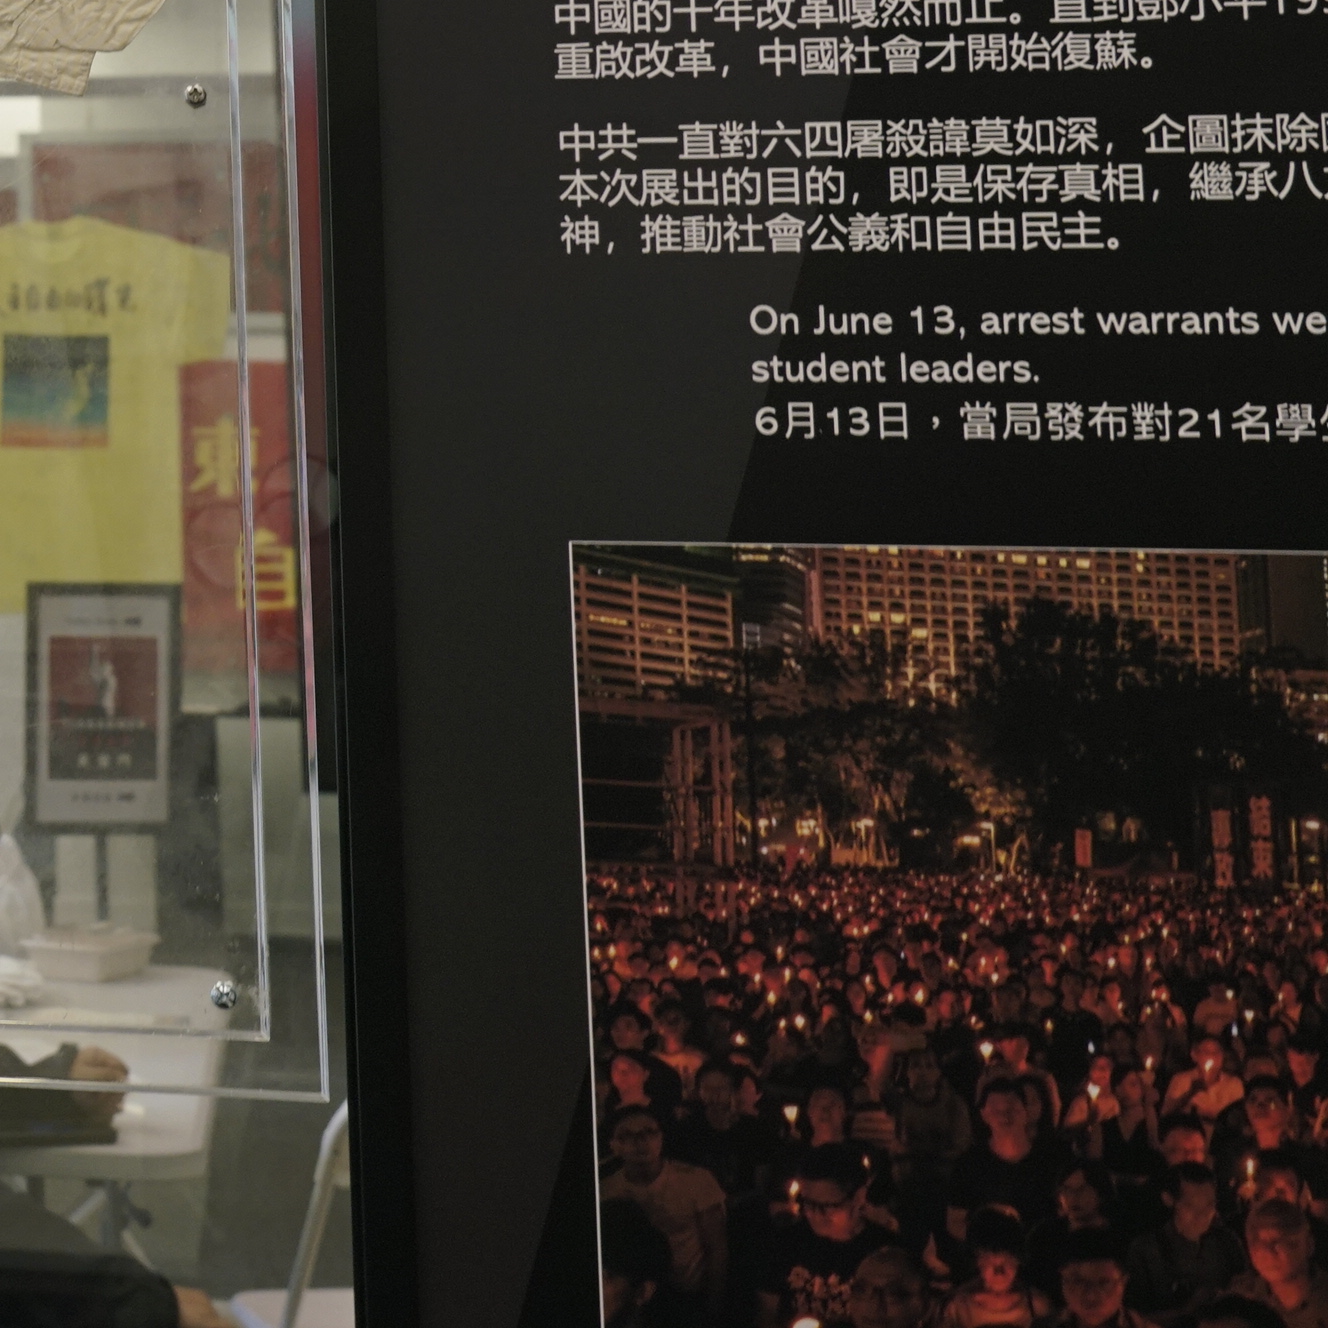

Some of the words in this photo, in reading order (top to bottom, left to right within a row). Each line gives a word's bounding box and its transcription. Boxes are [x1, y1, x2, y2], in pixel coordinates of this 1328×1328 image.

[558, 112, 1328, 162] 中共一直對六四屠殺諱莫如深，企圖抹除
[559, 160, 1328, 208] 本次展出的目的，即是保存真相，繼承八
[750, 305, 799, 335] On
[813, 304, 892, 335] June
[910, 305, 965, 340] 13,
[981, 307, 1085, 334] arrest
[1096, 307, 1260, 334] warrants
[1272, 312, 1326, 334] we
[752, 352, 886, 383] student
[900, 352, 1039, 383] leaders.
[755, 401, 1328, 440] 6月13日，當局發布對21名學
